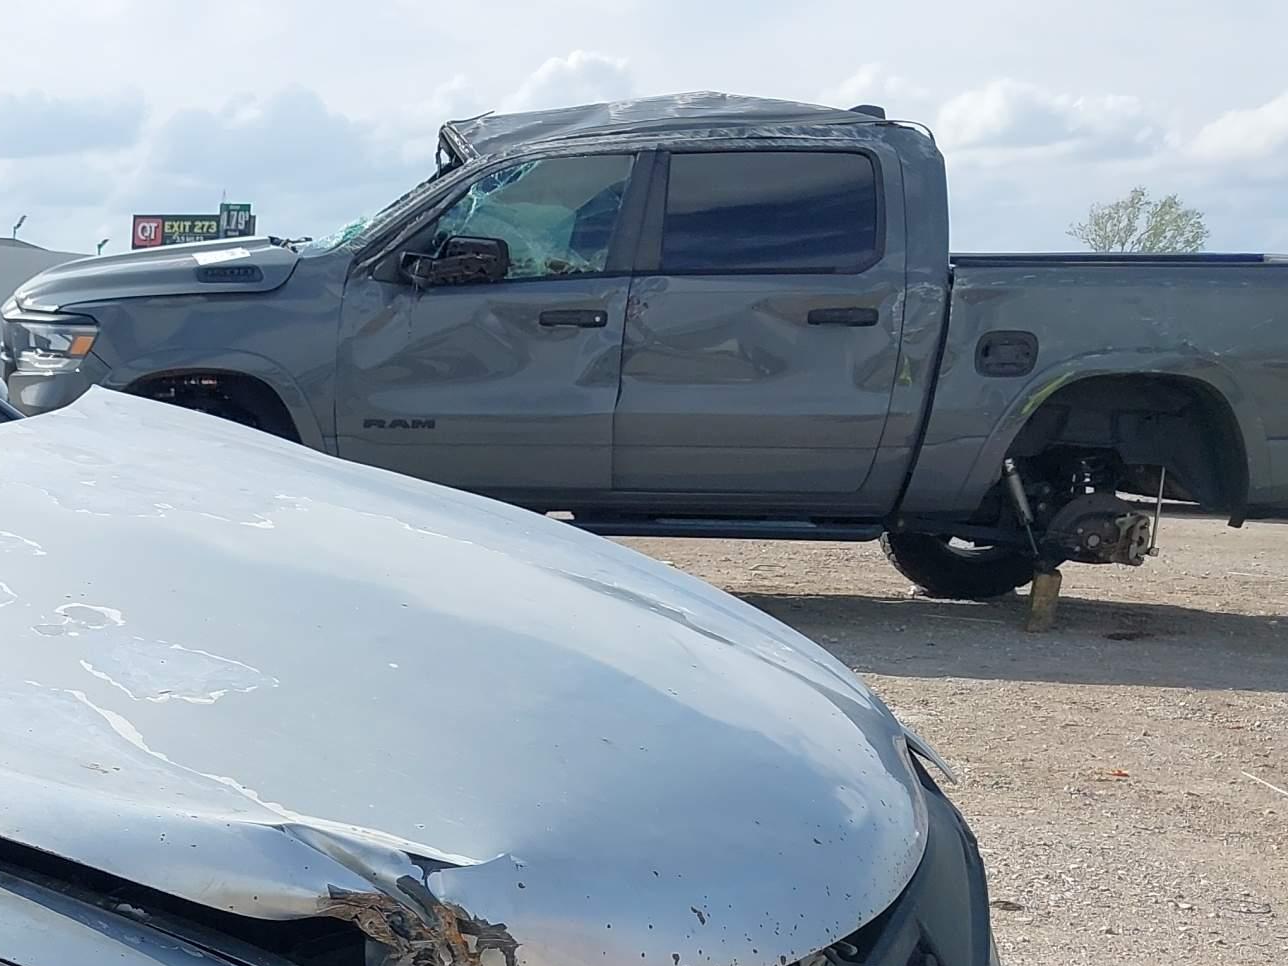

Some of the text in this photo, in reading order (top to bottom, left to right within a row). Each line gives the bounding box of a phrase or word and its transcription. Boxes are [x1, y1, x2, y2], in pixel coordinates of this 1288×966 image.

[137, 222, 158, 241] QT
[164, 221, 191, 233] EXIT
[193, 220, 217, 233] 273
[363, 418, 436, 429] RAM
